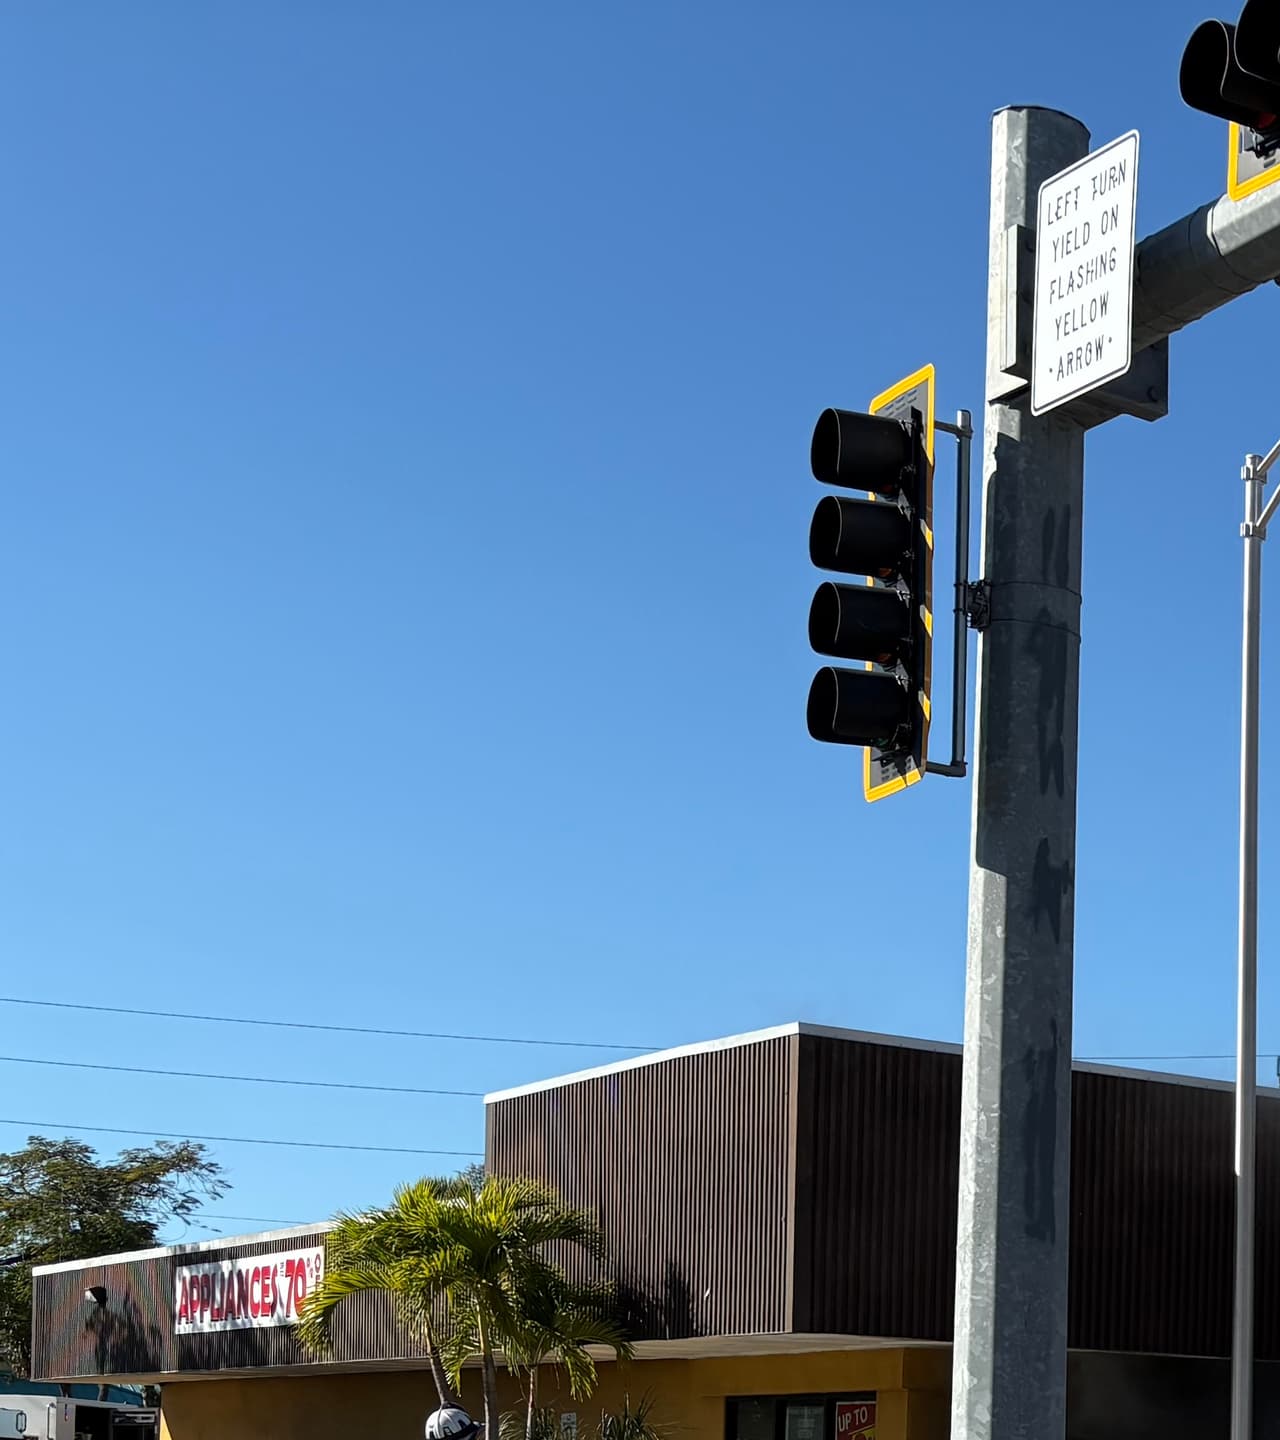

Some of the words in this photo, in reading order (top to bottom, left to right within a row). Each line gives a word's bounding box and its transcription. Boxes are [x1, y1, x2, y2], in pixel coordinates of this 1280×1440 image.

[1047, 186, 1081, 226] LEFT
[1091, 159, 1127, 200] TURN
[1052, 220, 1091, 263] YIELD
[1100, 204, 1119, 235] ON
[1049, 246, 1118, 305] FLASHING
[1054, 290, 1110, 341] YELLOW
[1057, 333, 1105, 382] ARROW
[177, 1263, 278, 1325] APPLIANCES
[838, 1412, 851, 1432] UP
[853, 1406, 868, 1426] TO
